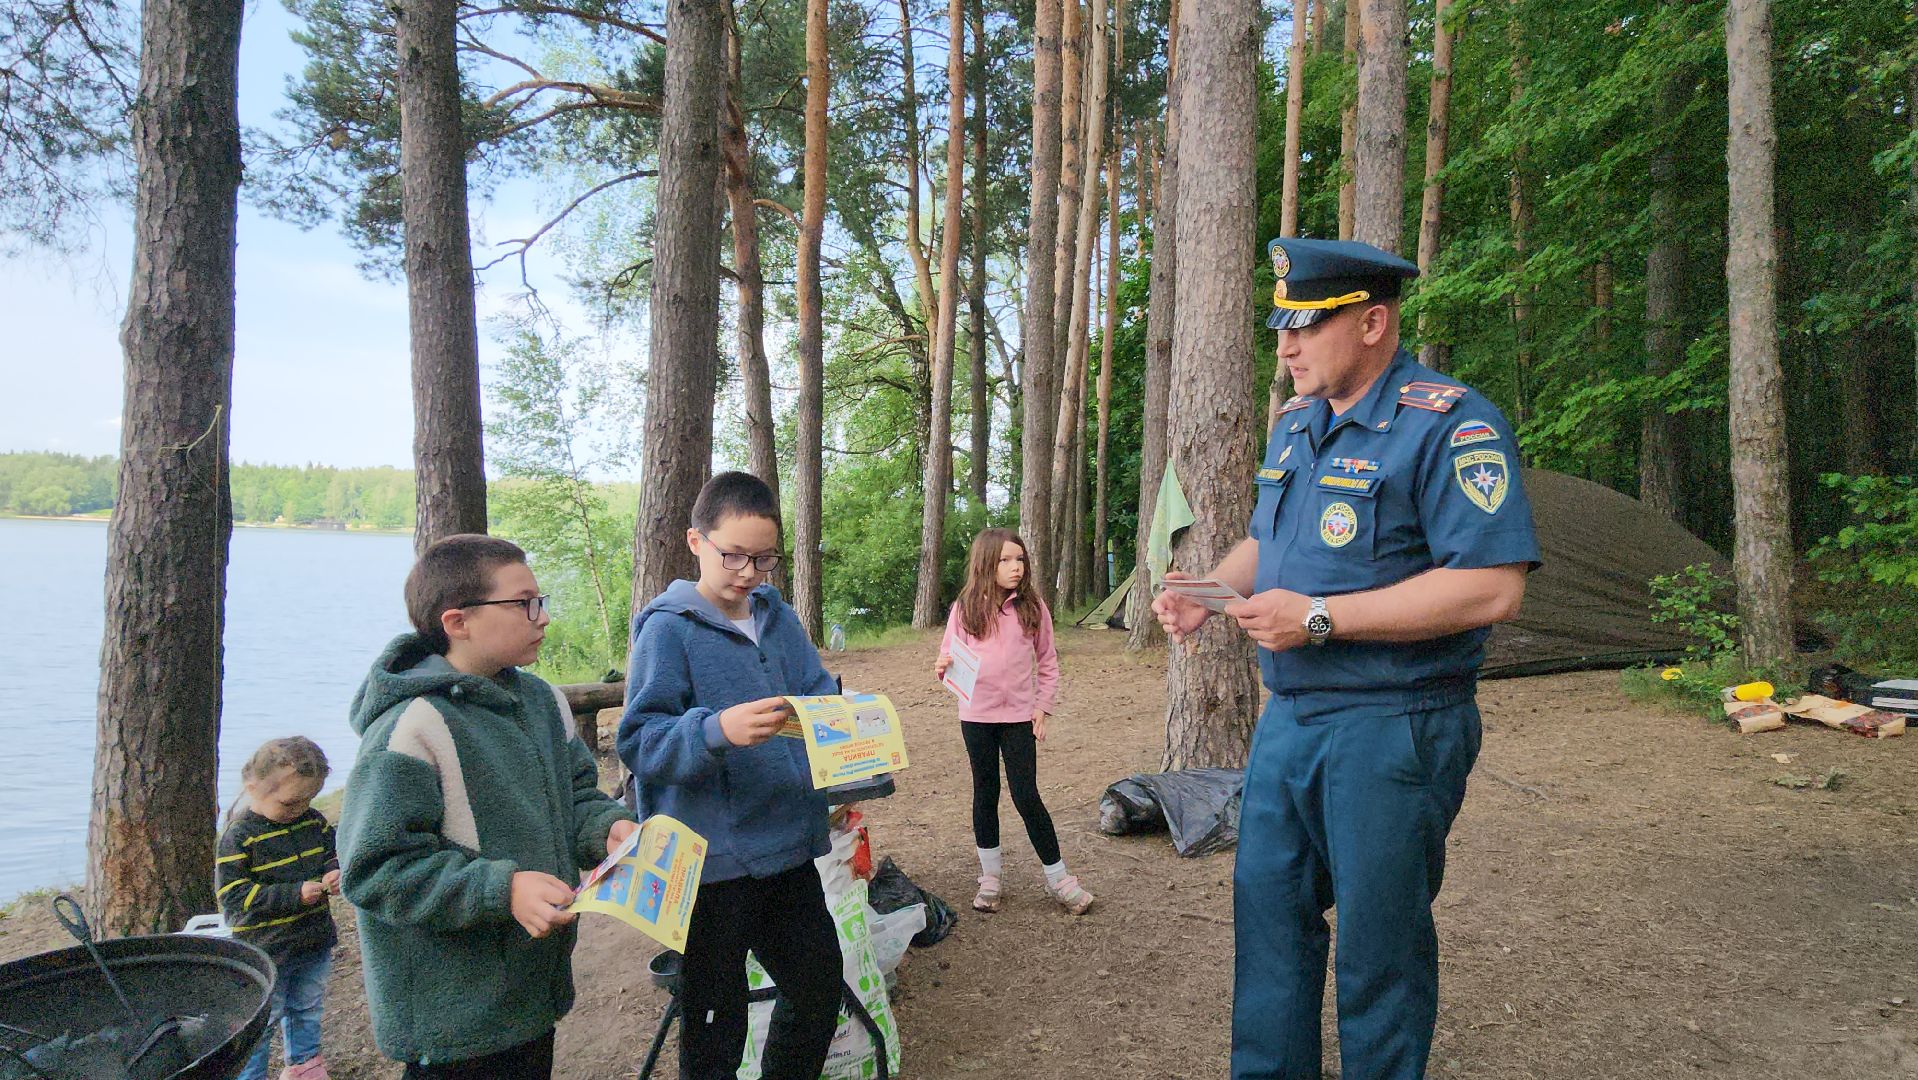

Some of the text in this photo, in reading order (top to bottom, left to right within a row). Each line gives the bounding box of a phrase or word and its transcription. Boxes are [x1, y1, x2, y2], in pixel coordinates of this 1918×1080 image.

[1459, 453, 1501, 466] МЧС РОССИИ
[844, 750, 876, 762] ПРАВИЛА
